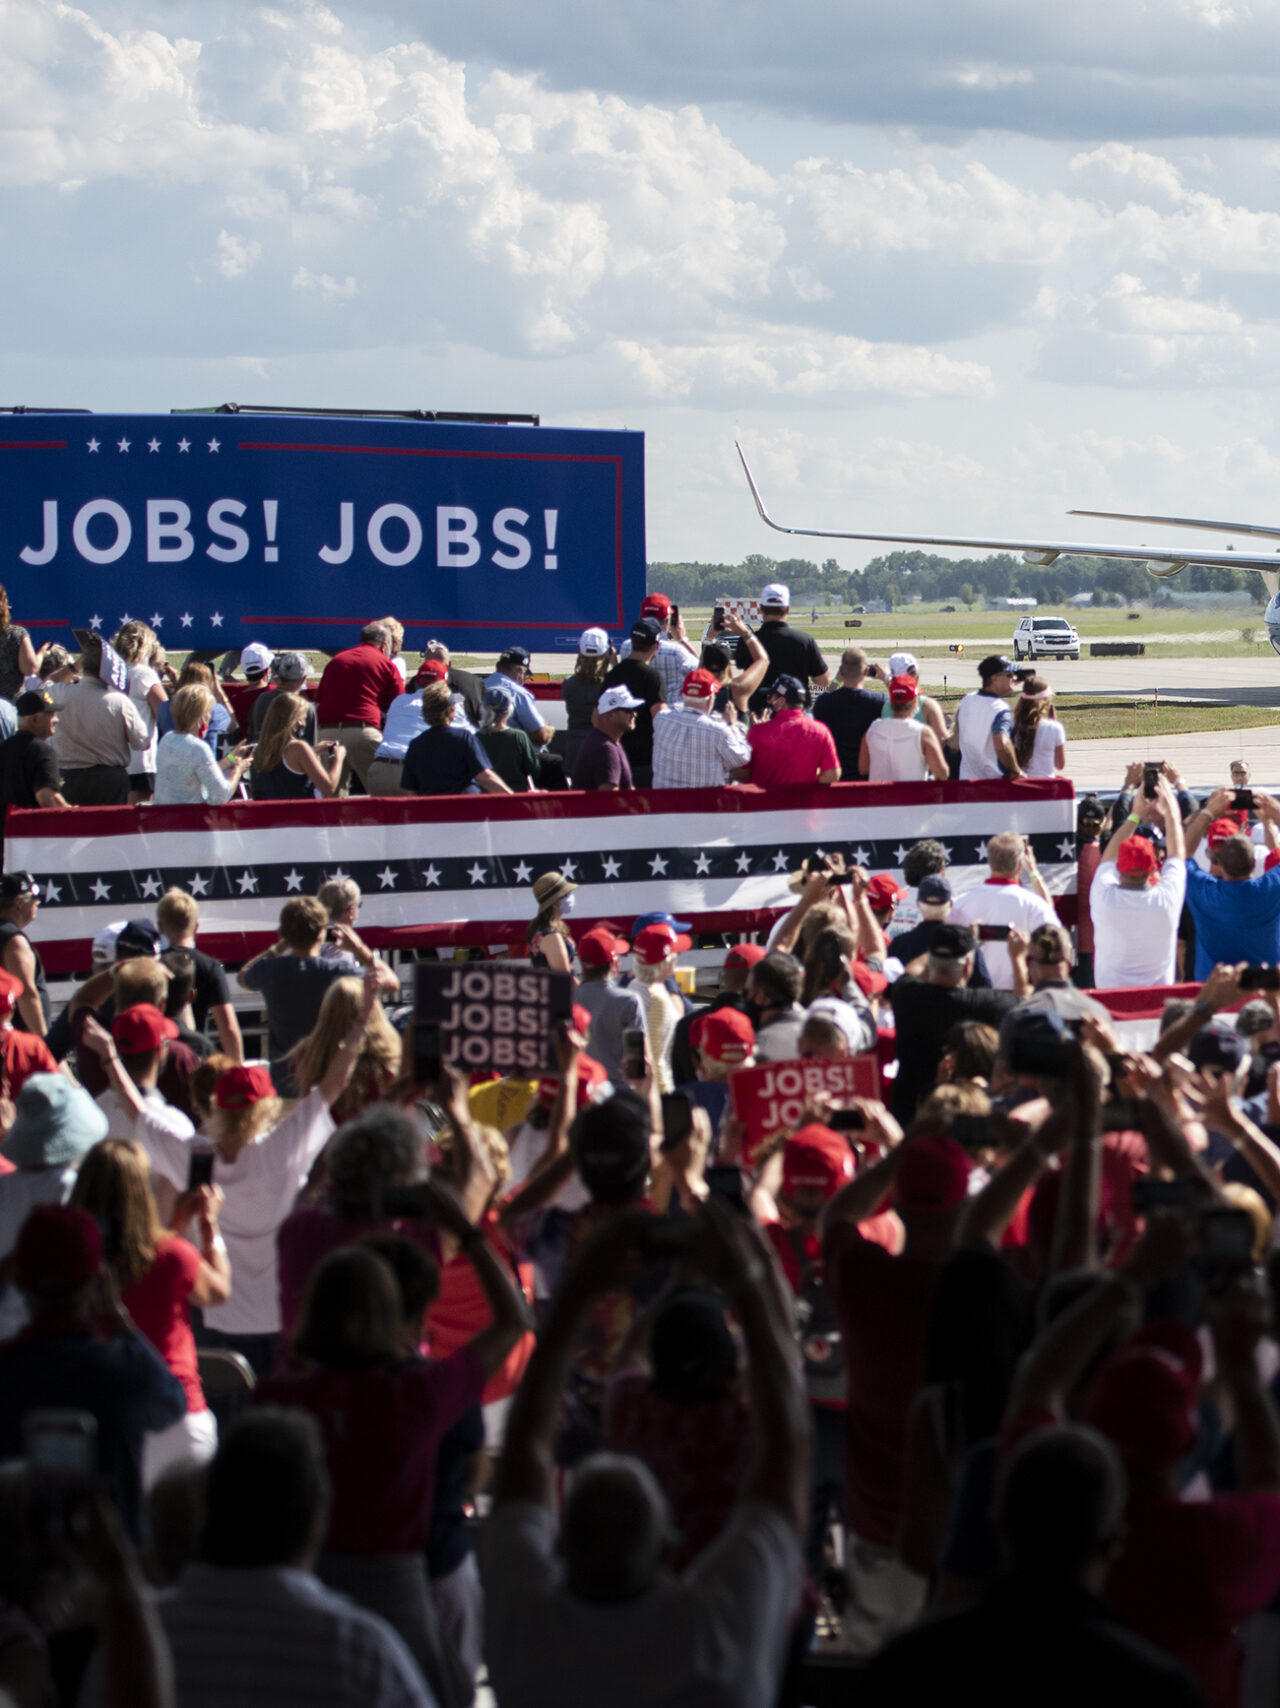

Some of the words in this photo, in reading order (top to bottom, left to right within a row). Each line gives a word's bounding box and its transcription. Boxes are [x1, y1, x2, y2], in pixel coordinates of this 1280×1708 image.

[19, 499, 279, 565] JOBS!
[318, 502, 559, 570] JOBS!
[441, 970, 549, 1003] JOBS!
[440, 1003, 549, 1036] JOBS!
[441, 1036, 548, 1069] JOBS!
[757, 1066, 855, 1098] JOBS!
